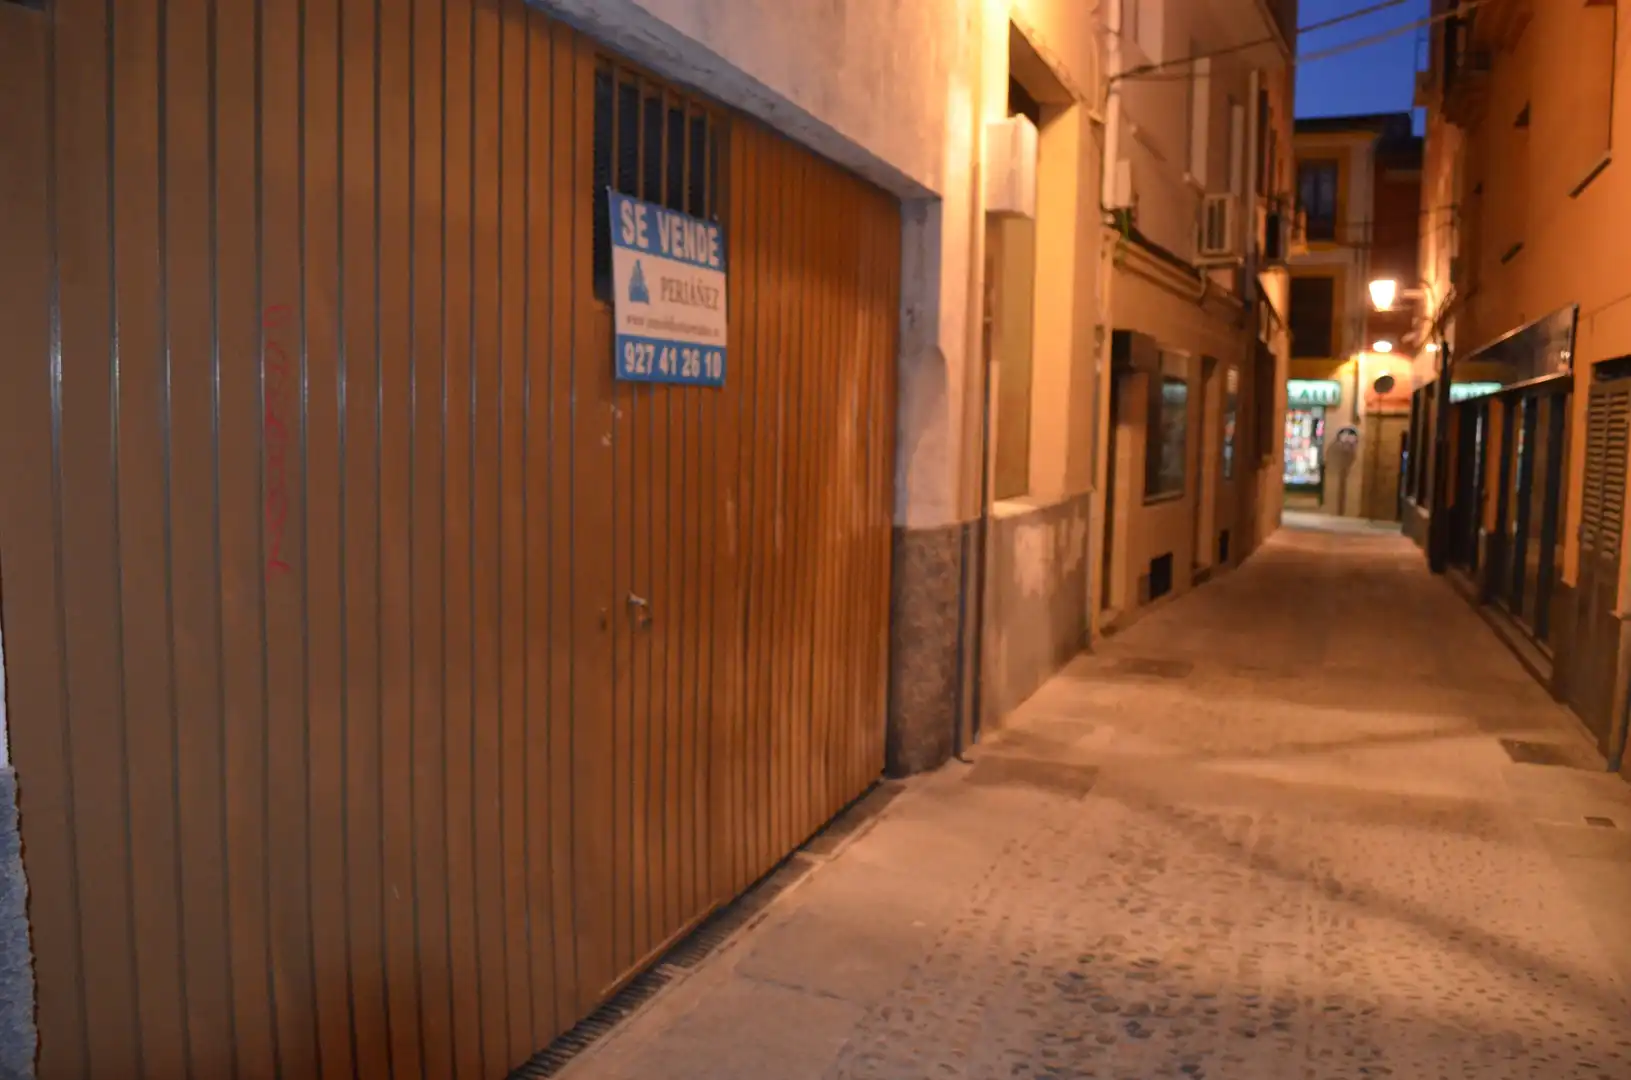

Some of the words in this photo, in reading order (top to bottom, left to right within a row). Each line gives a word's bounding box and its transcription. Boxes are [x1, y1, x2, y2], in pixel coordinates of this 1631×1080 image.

[620, 200, 649, 248] SE
[656, 211, 720, 267] VENDE
[624, 341, 655, 375] 927
[659, 345, 677, 376] 41
[681, 348, 700, 378] 26
[704, 351, 722, 380] 10
